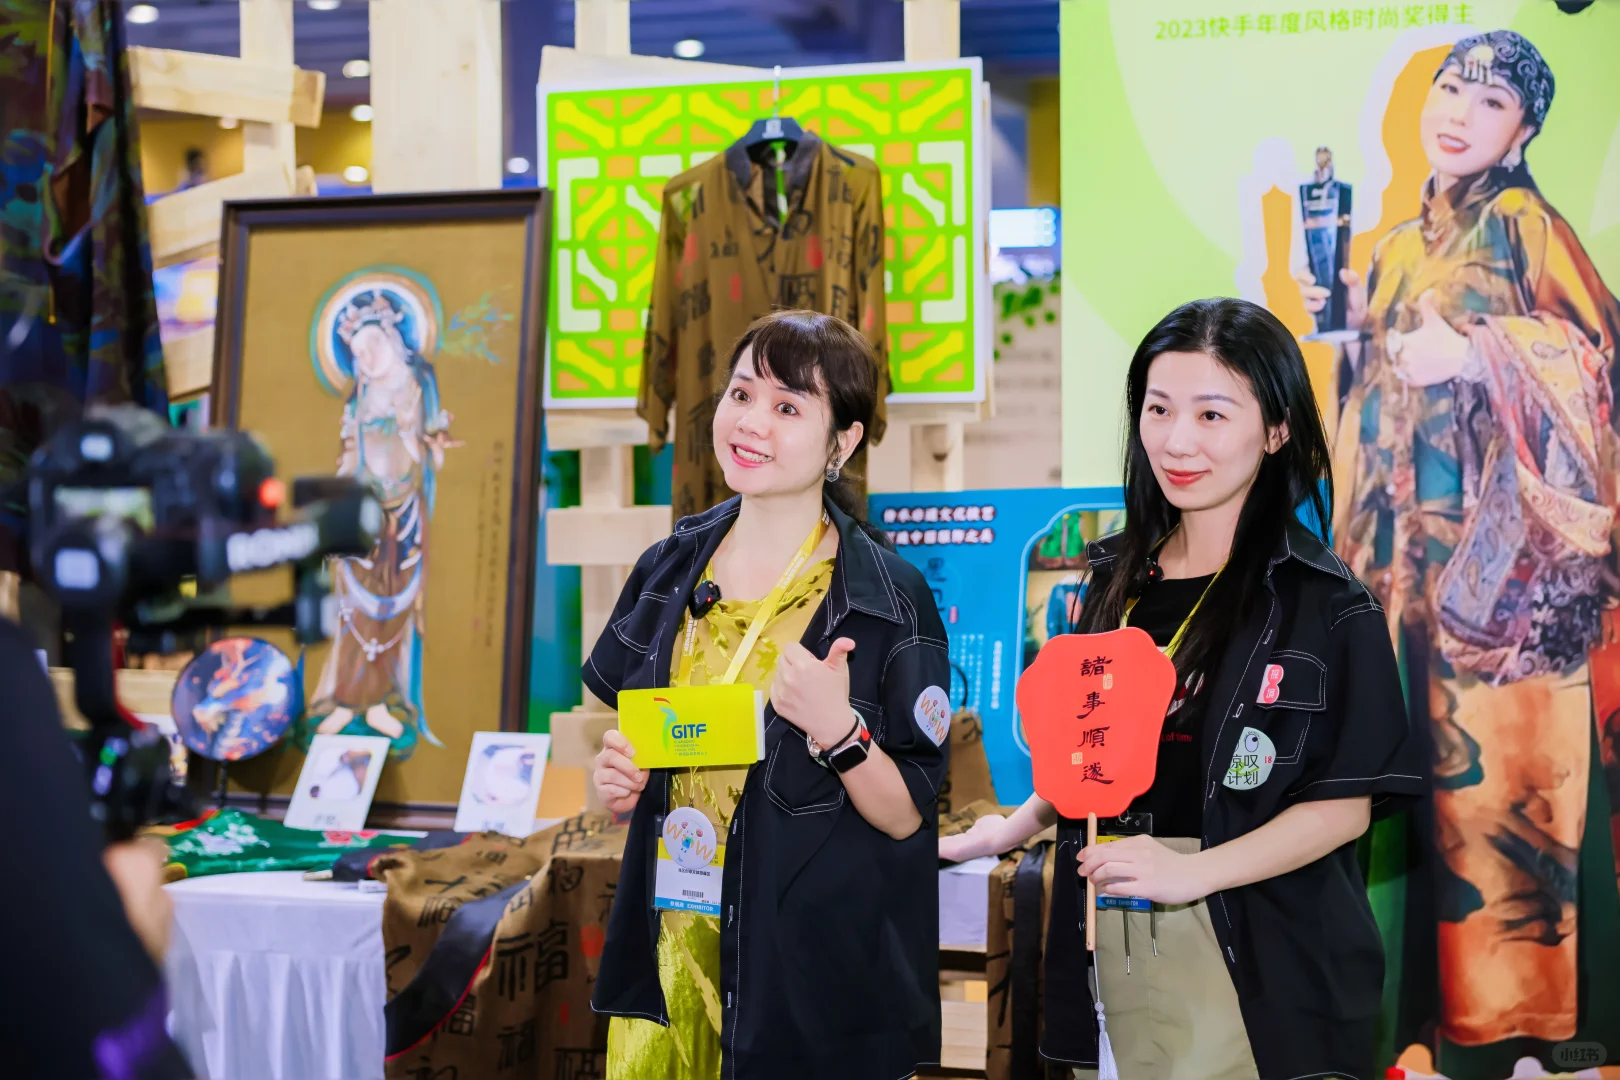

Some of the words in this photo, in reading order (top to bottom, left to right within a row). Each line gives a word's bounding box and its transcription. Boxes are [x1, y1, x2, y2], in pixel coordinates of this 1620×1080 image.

[1155, 3, 1476, 41] 2023快手年度风格时尚奖得主
[671, 723, 707, 739] GITF
